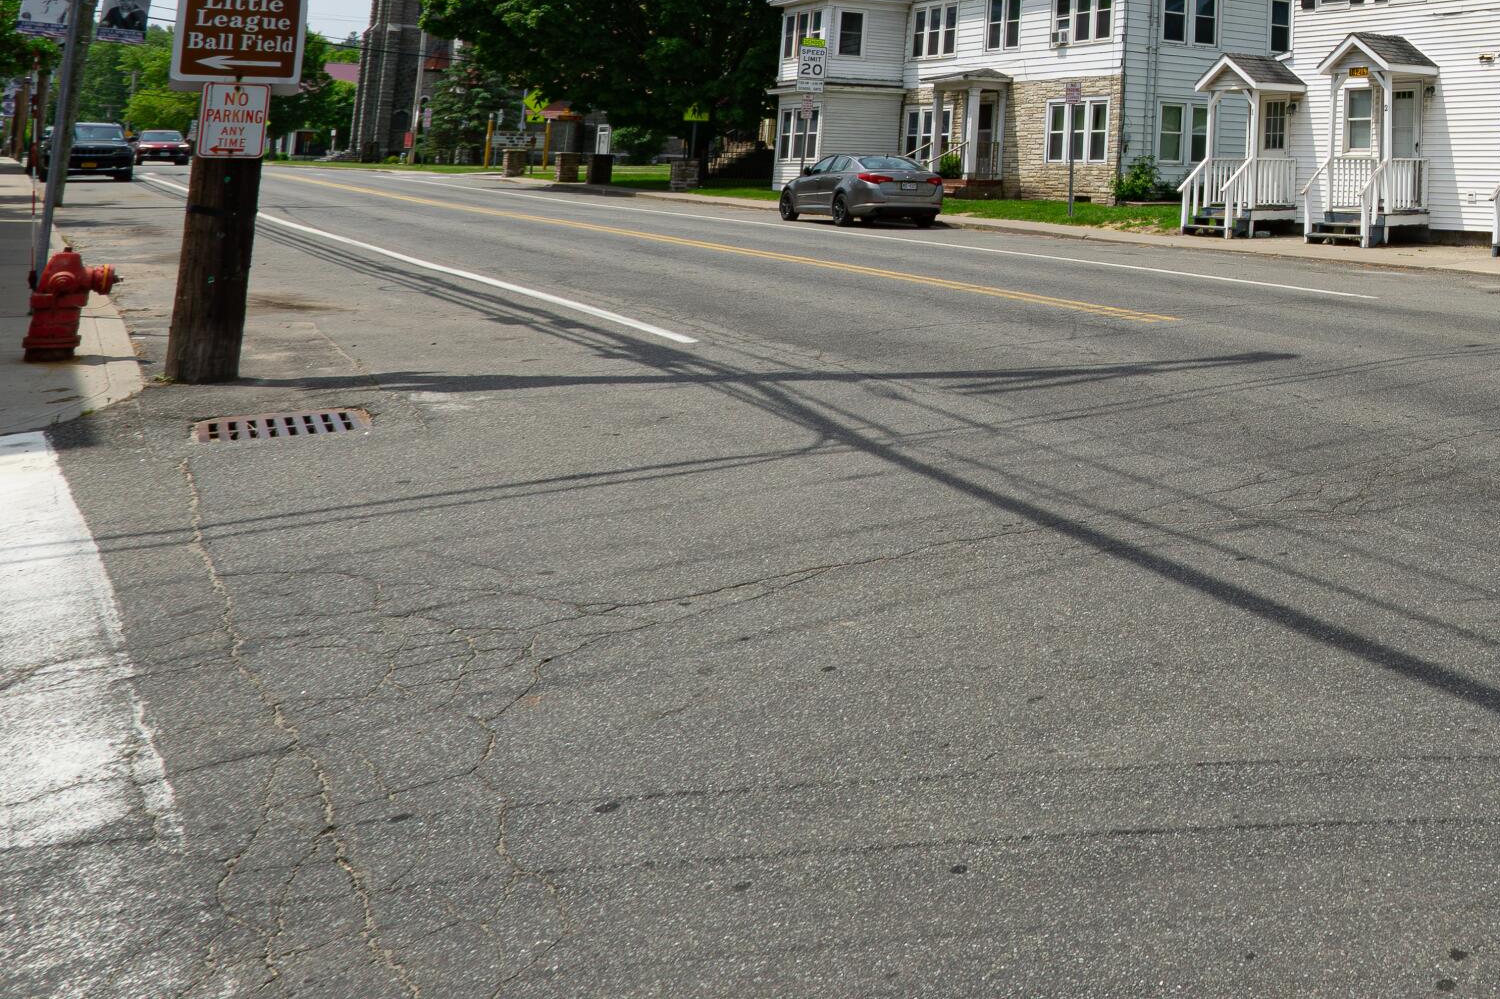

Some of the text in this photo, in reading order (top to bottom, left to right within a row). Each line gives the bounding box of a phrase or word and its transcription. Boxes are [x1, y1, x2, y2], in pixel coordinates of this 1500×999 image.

[195, 9, 291, 33] League
[187, 32, 294, 53] Ball Field
[801, 63, 823, 76] 20
[224, 92, 249, 106] NO
[205, 108, 264, 124] PARKING
[220, 126, 246, 136] ANY
[217, 137, 247, 148] TIME
